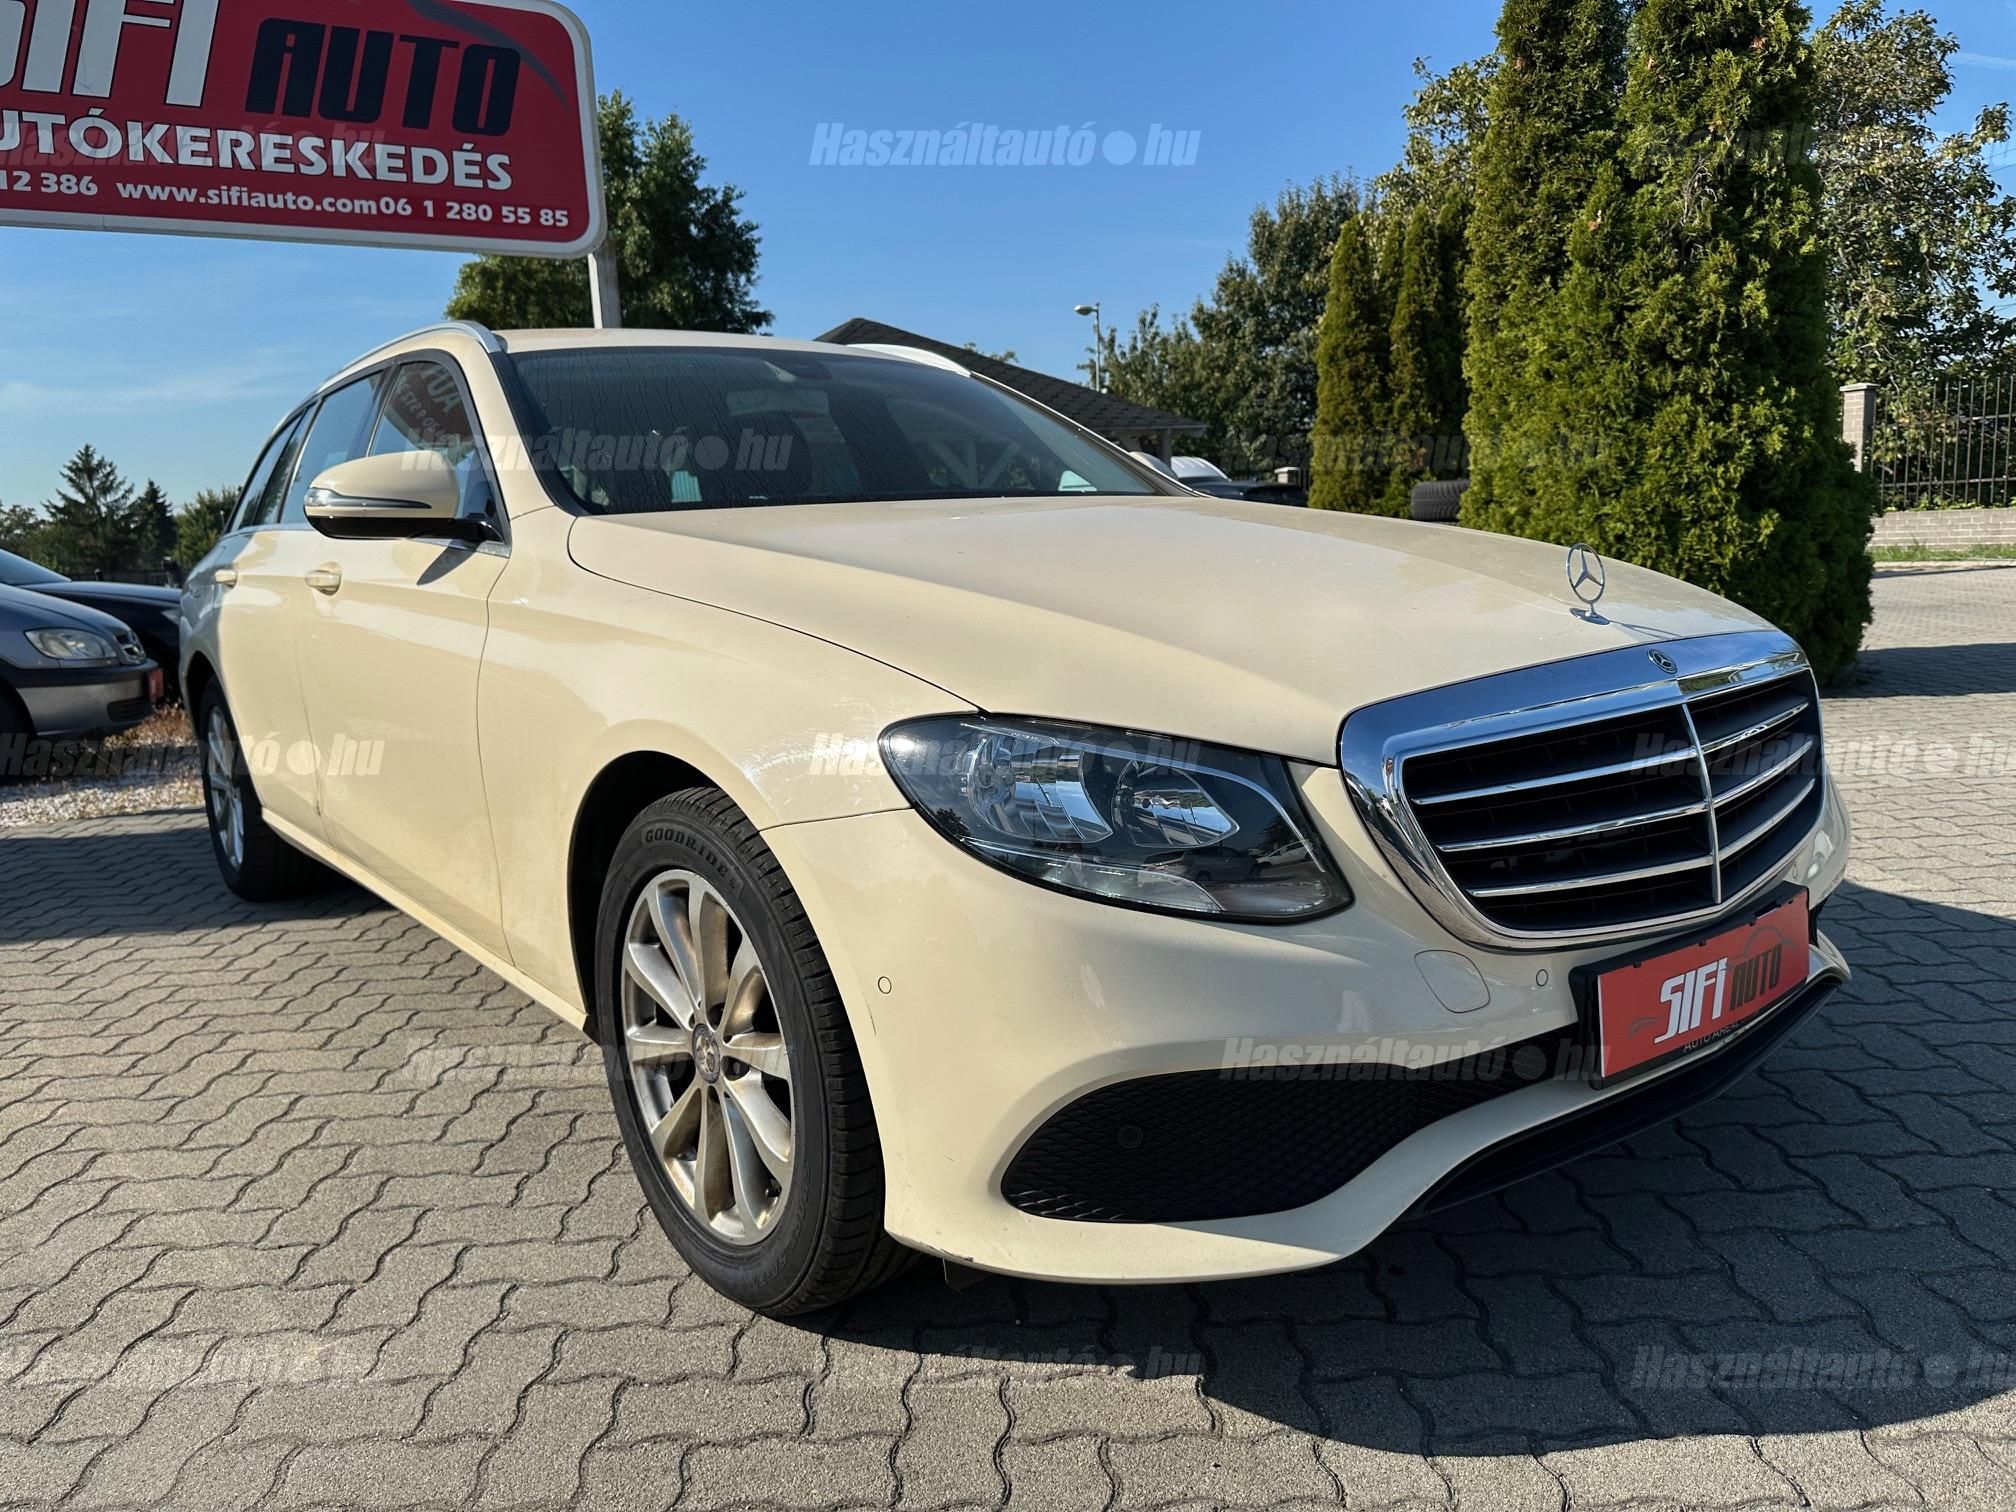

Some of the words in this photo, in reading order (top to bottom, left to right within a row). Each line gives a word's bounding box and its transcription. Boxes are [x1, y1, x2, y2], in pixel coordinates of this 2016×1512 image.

[244, 17, 522, 137] AUTO
[40, 172, 98, 196] 386
[116, 183, 377, 215] www.sifiauto.com
[380, 197, 412, 216] 06
[423, 201, 434, 218] 1
[446, 202, 493, 222] 280
[501, 206, 531, 224] 55
[539, 210, 569, 227] 85
[645, 828, 730, 877] GOODRIDE
